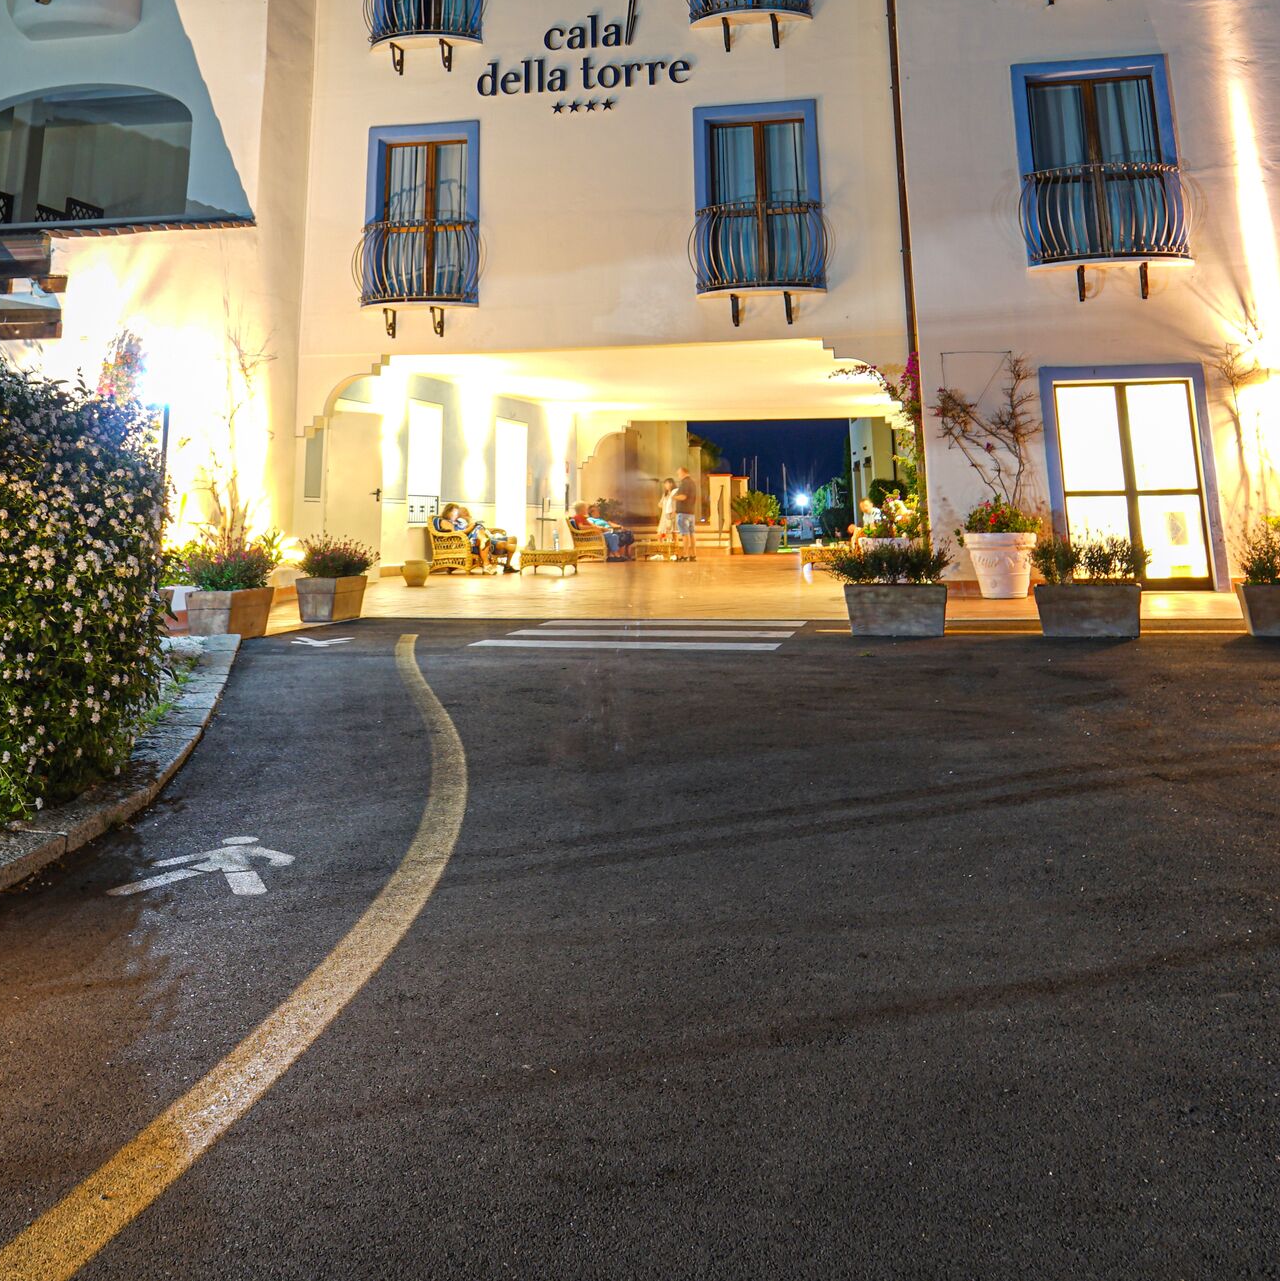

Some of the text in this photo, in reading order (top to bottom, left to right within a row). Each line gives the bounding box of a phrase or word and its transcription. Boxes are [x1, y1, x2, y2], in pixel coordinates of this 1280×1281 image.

[543, 15, 622, 51] cala
[477, 56, 690, 97] della torre
